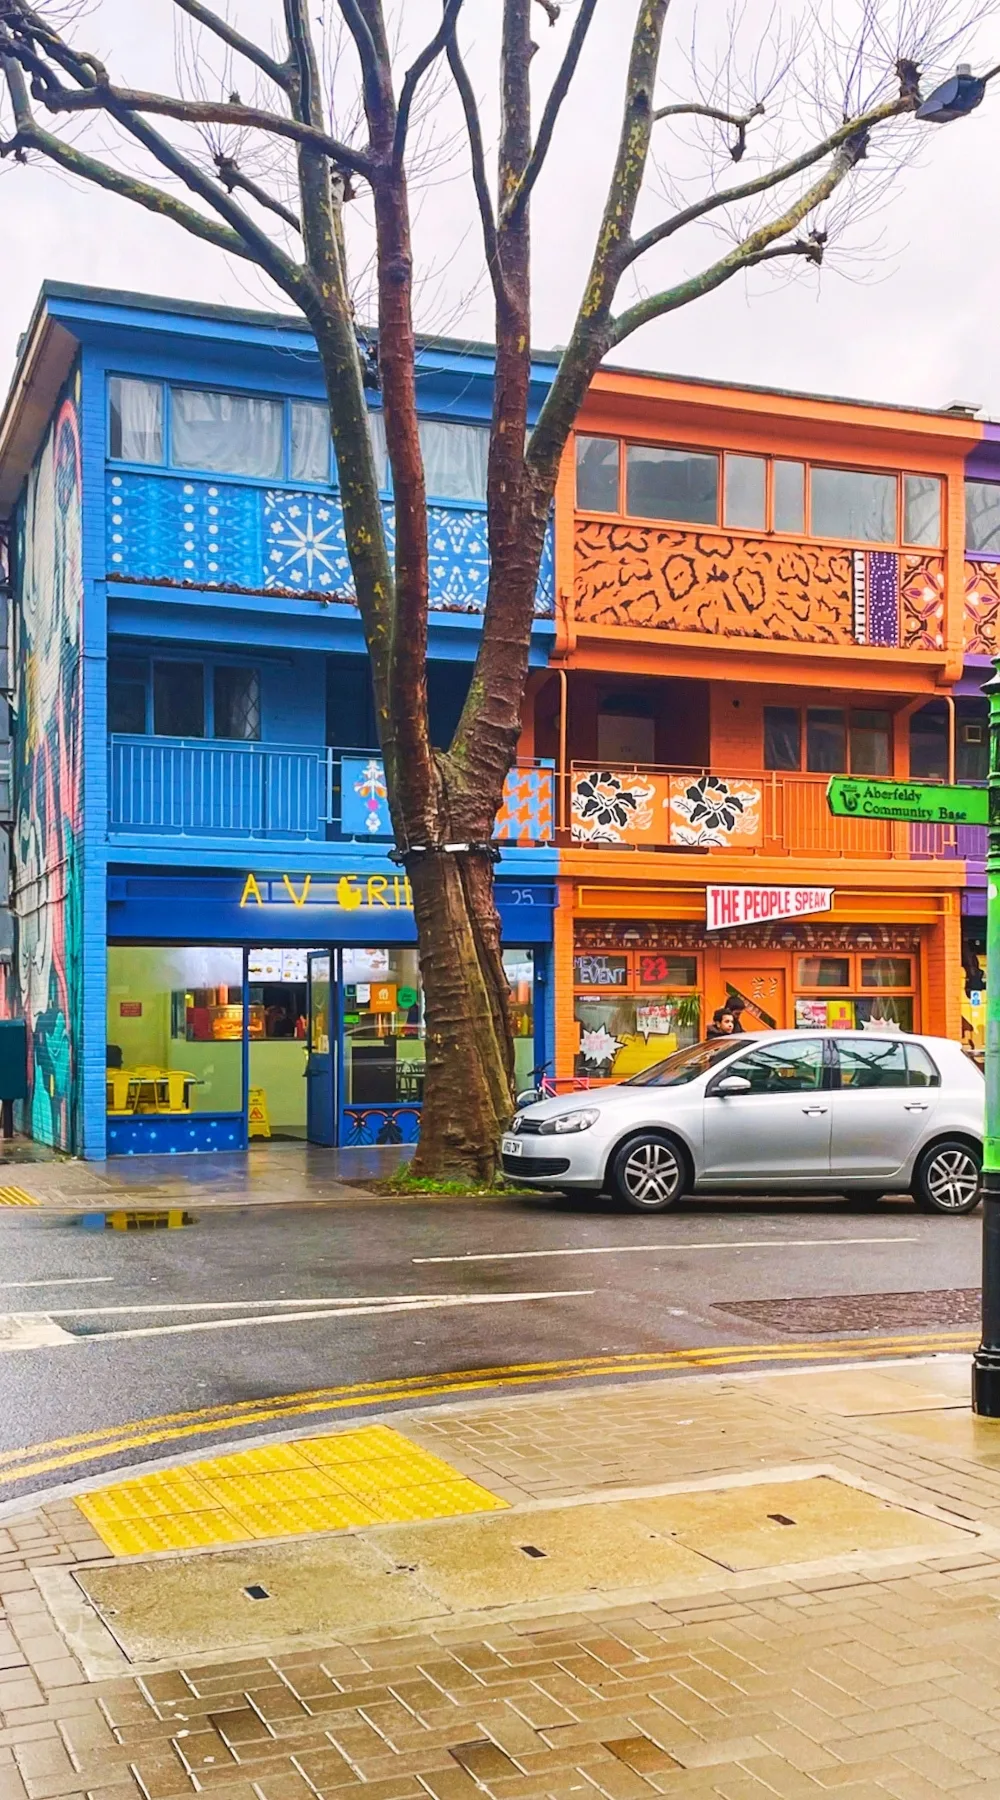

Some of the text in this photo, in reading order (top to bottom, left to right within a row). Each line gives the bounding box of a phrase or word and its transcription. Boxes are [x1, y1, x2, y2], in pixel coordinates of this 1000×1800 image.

[863, 786, 922, 803] Aberfeldy
[863, 801, 967, 821] Community Base
[511, 888, 535, 905] 25
[711, 889, 827, 926] THE PEOPLE SPEAK
[573, 956, 609, 969] NEXT
[642, 956, 669, 982] 23
[579, 966, 626, 985] EVENT
